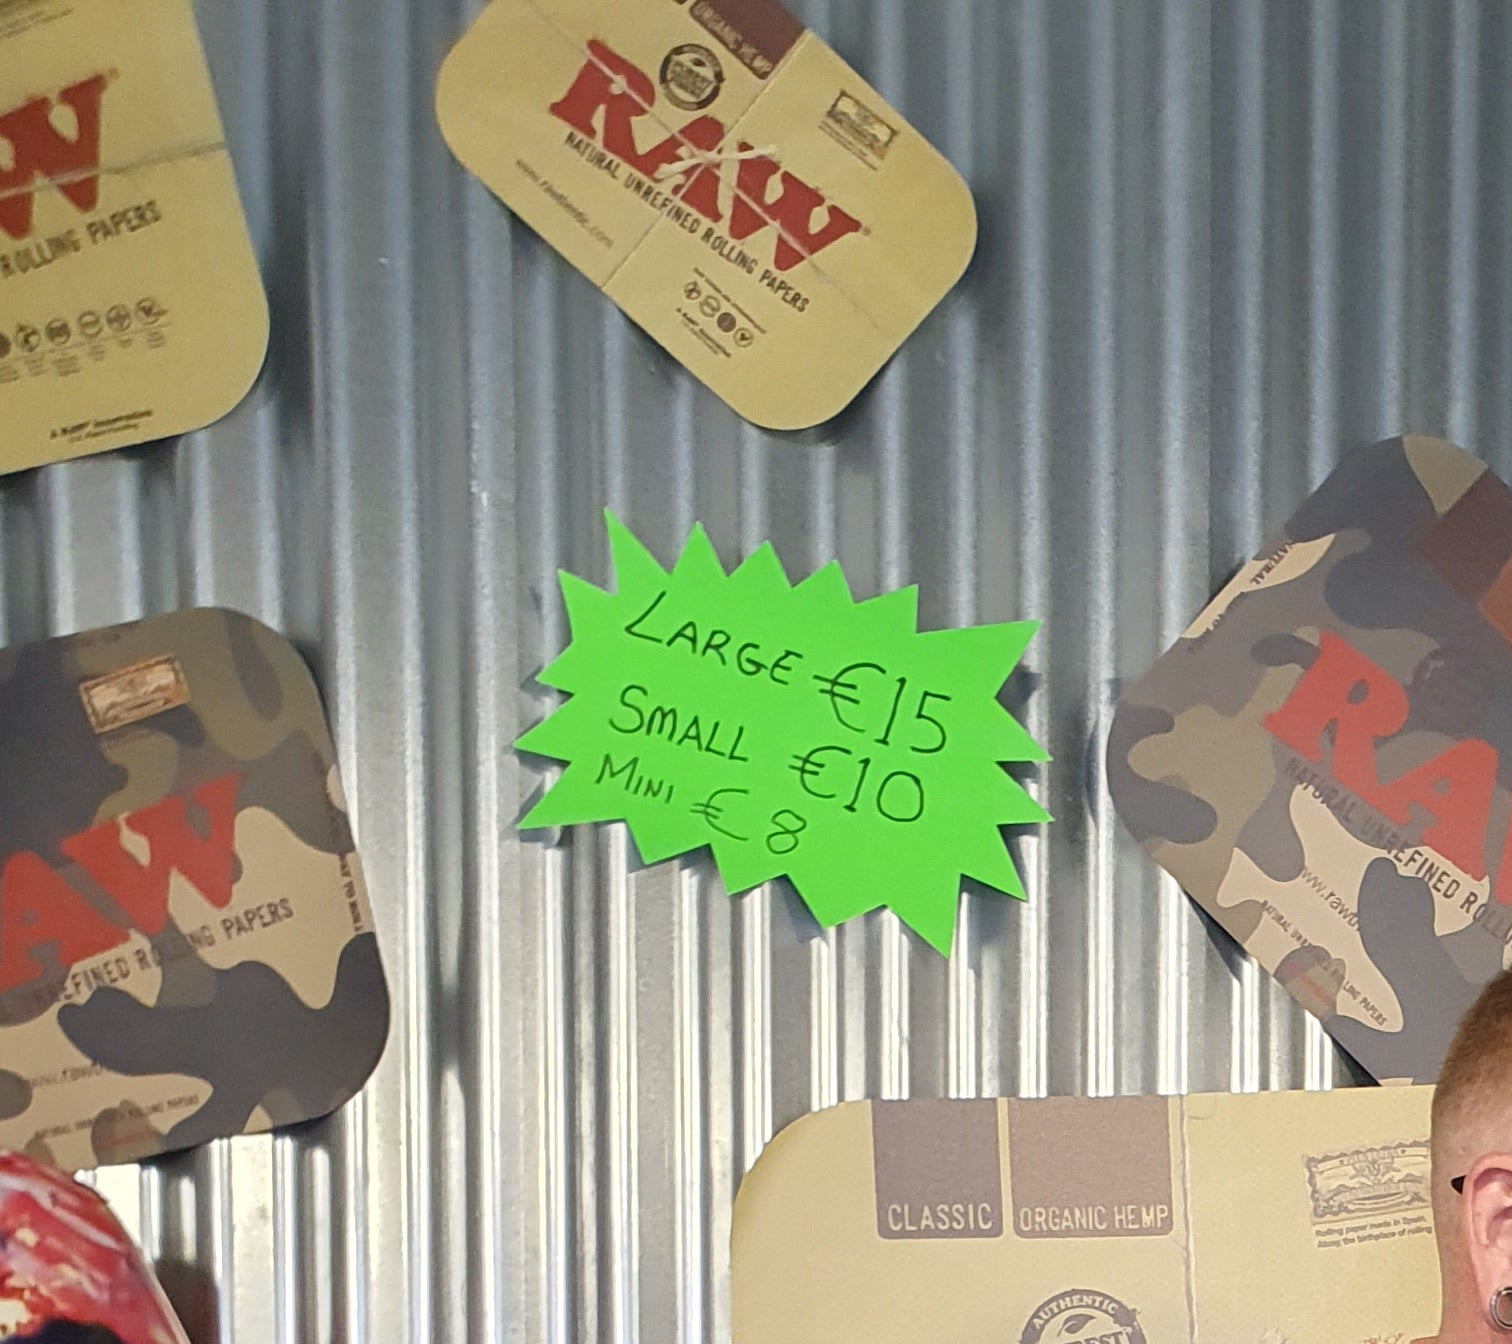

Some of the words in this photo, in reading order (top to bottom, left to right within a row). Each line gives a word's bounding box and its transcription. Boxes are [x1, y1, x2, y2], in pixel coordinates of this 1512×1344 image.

[548, 39, 863, 272] RAW
[86, 200, 161, 246] PAPERS
[564, 131, 619, 183] NATURAL
[625, 169, 701, 236] UNREFINED
[701, 226, 760, 280] ROLLING
[760, 270, 811, 315] PAPERS
[624, 590, 804, 686] LARGE
[812, 661, 953, 754] €15
[595, 753, 675, 805] MINI
[608, 684, 749, 764] SMALL
[788, 746, 926, 823] €10
[1283, 756, 1356, 827] NATURAL
[1361, 814, 1461, 901] UNREFINED
[222, 898, 295, 942] PAPERS
[887, 1203, 994, 1233] CLASSIC
[1018, 1203, 1109, 1234] ORGANIC
[1112, 1203, 1170, 1230] HEMP
[1032, 1294, 1119, 1330] AUTHENTIC
